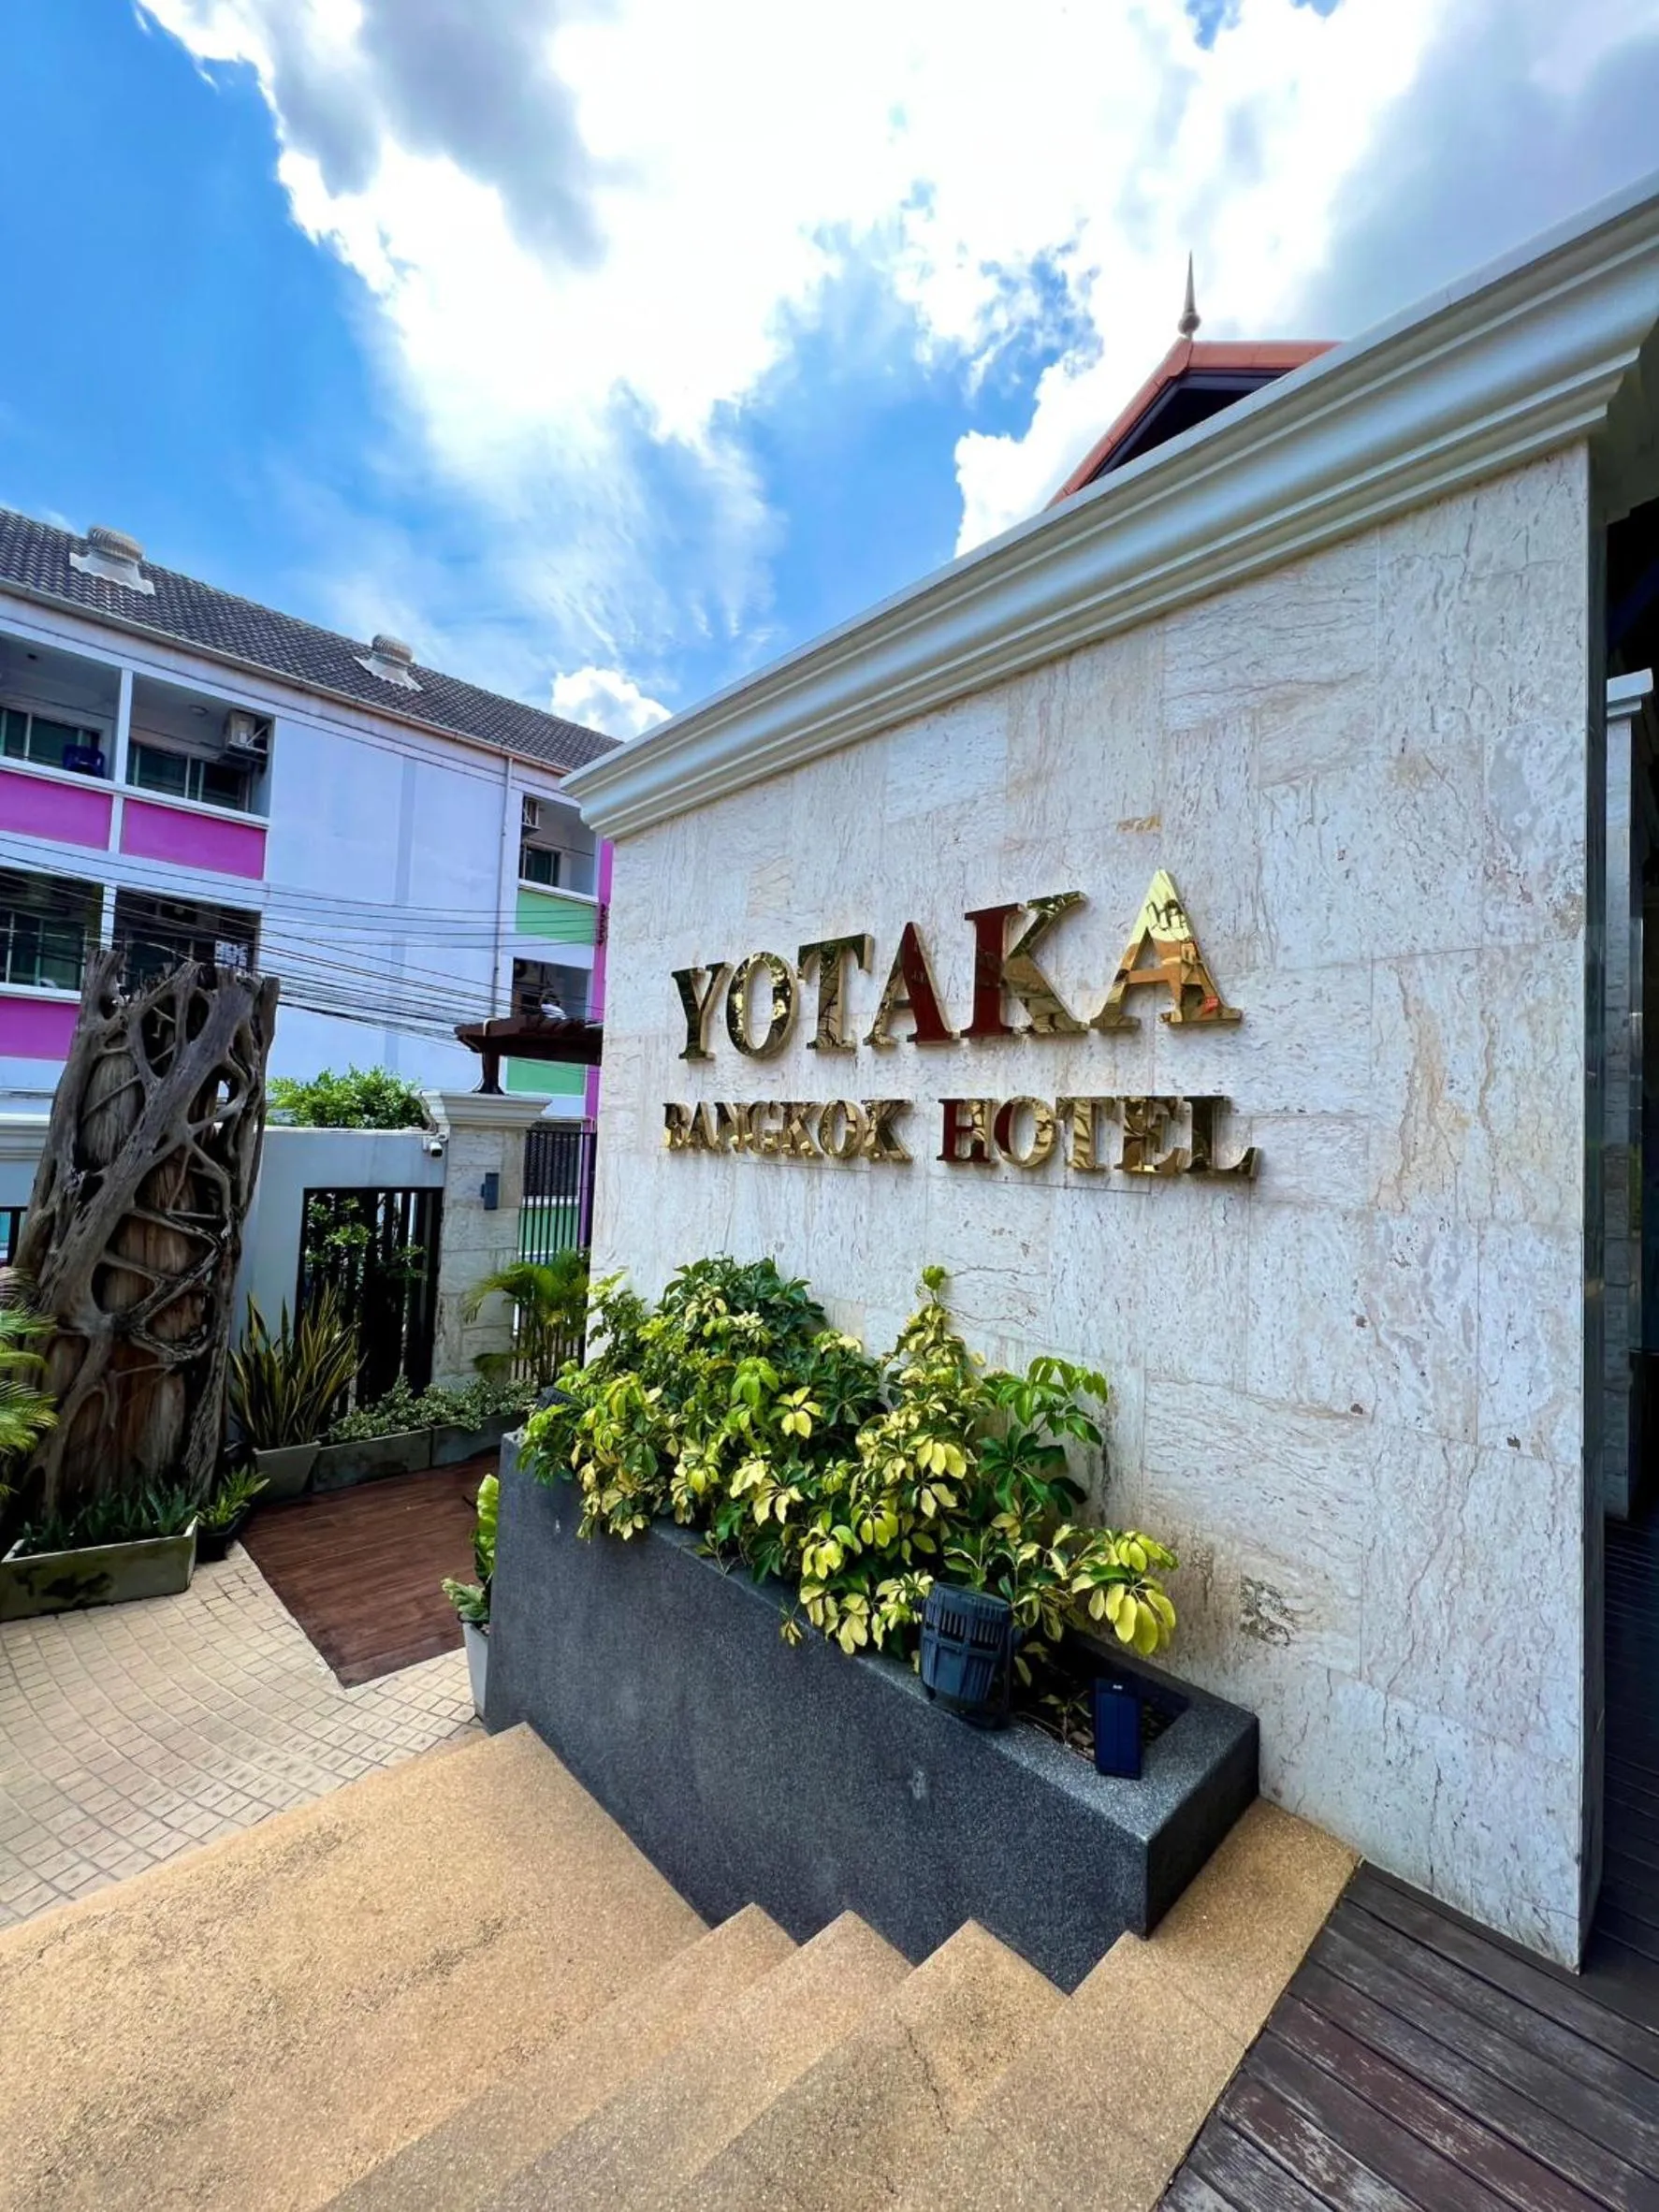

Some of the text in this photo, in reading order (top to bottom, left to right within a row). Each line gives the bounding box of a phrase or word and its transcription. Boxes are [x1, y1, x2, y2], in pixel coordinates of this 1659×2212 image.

[671, 868, 1243, 1059] YOTAKA
[662, 1095, 1261, 1180] BANGKOK HOTEL
